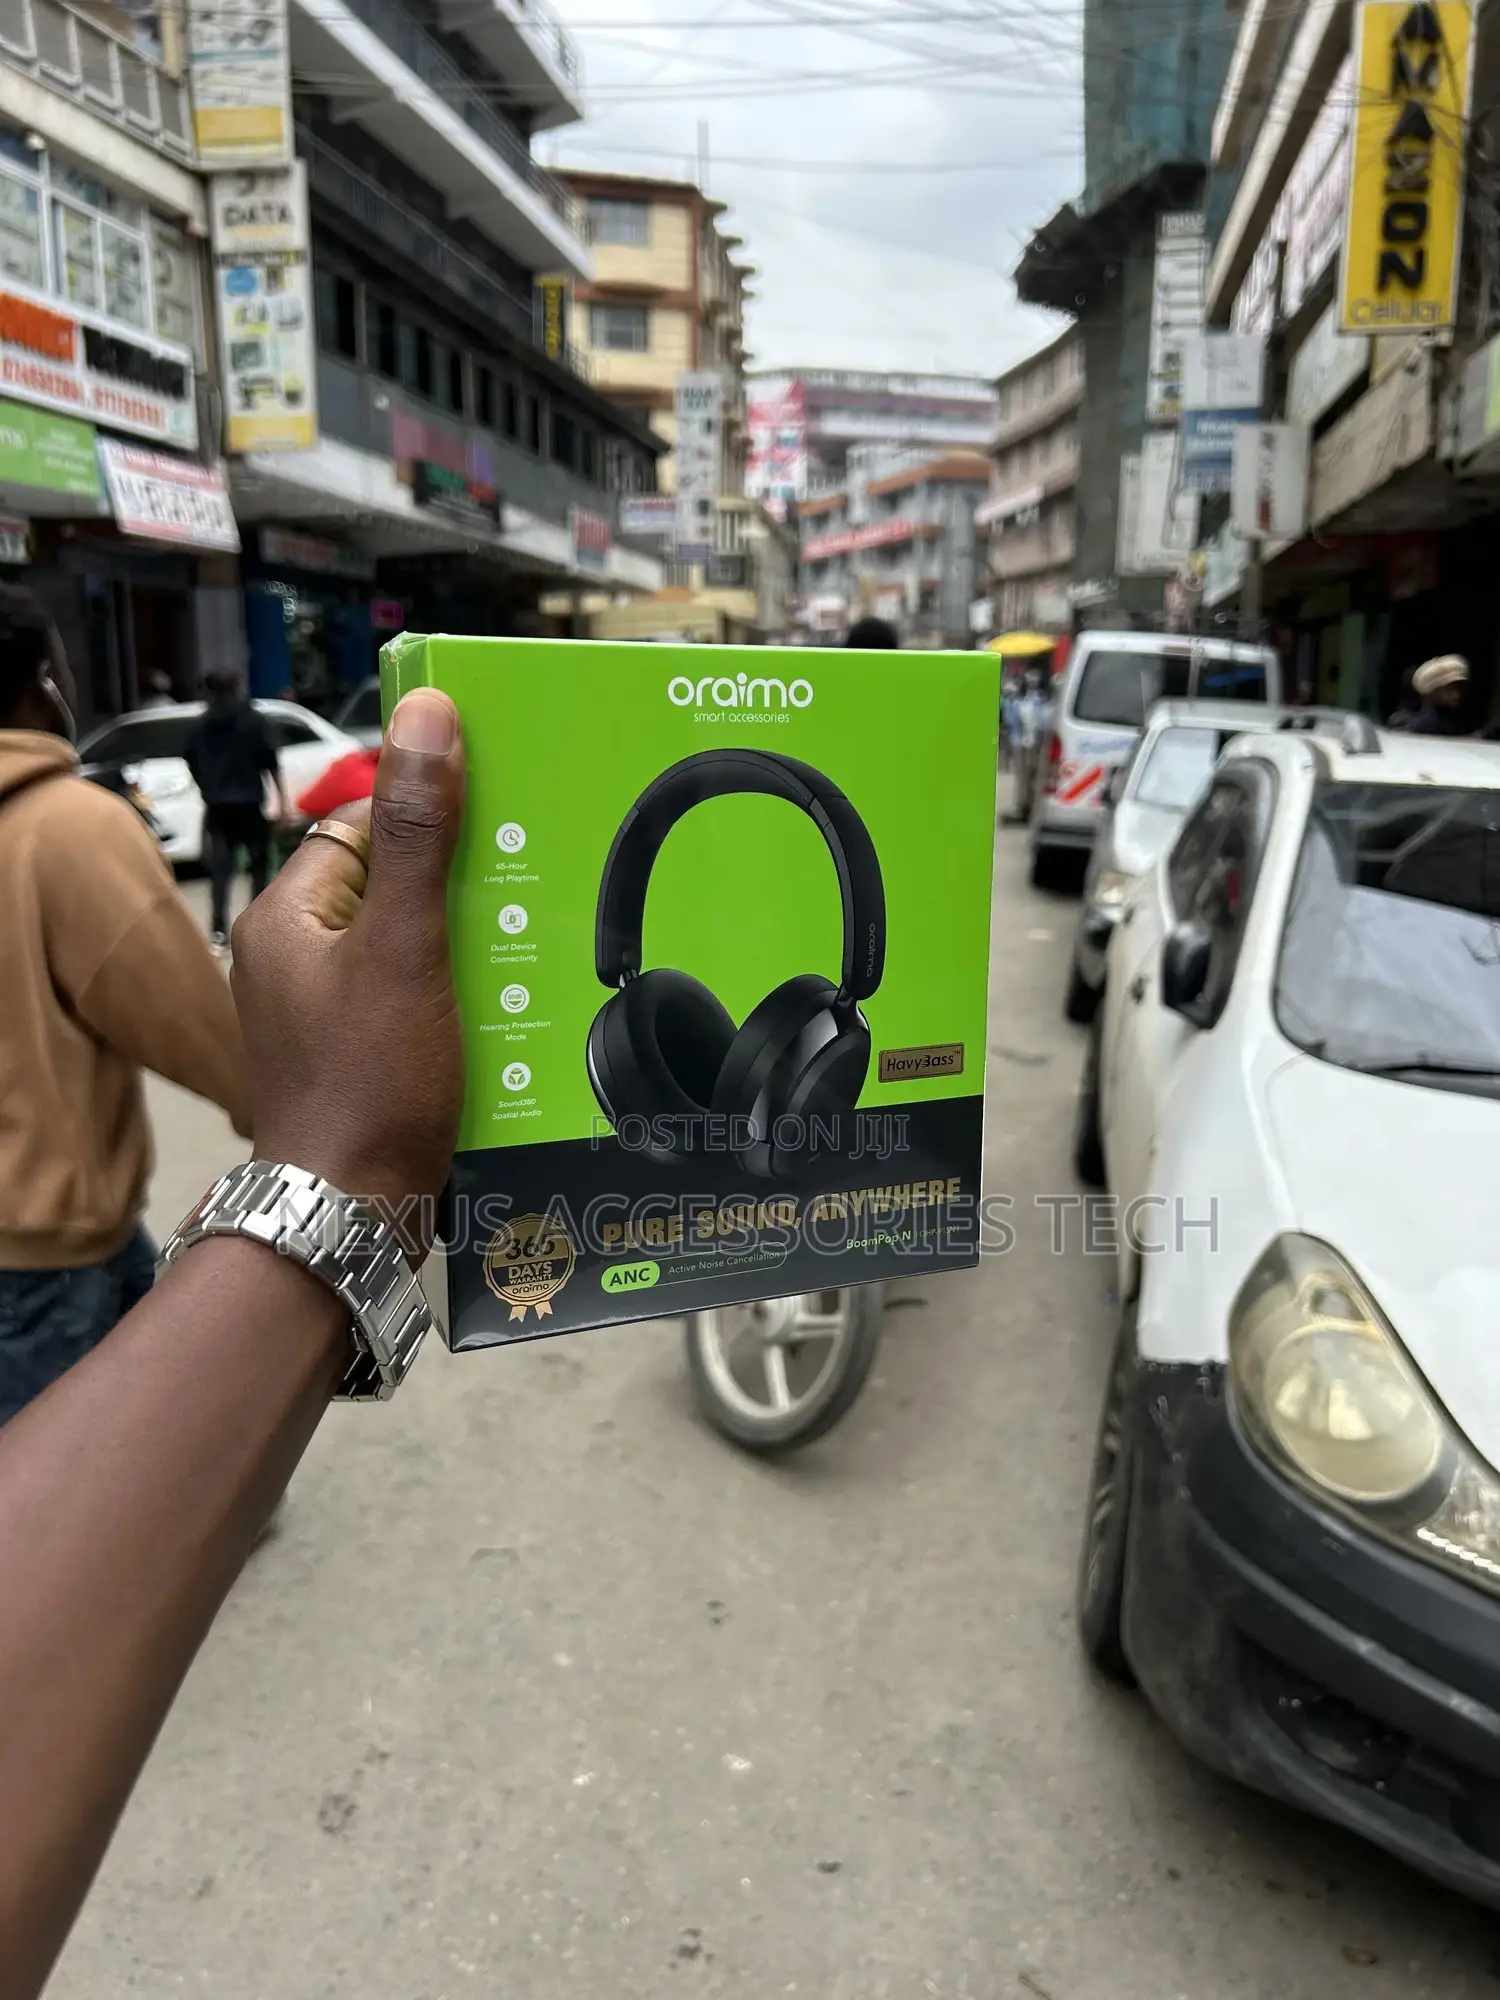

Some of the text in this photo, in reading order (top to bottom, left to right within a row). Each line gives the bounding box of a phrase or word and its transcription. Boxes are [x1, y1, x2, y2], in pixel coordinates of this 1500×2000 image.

[667, 672, 814, 708] oraimo
[694, 711, 790, 723] smart accessories
[484, 874, 540, 884] Long Playtime
[490, 942, 537, 952] Dual Device
[866, 922, 876, 978] oraimo
[490, 954, 538, 964] Connectivity
[479, 1020, 551, 1032] Hearing Protection
[504, 1033, 527, 1042] Mode
[498, 1098, 537, 1108] Sound360
[492, 1109, 542, 1121] Spatial Audio
[602, 1213, 685, 1252] PURE
[809, 1176, 962, 1223] ANYWHERE
[846, 1232, 900, 1250] BoomPop
[901, 1229, 912, 1242] N
[504, 1232, 556, 1260] 365
[668, 1250, 781, 1275] Active Noise Cancellation
[508, 1261, 553, 1279] DAYS
[510, 1273, 553, 1285] WARRANTY
[609, 1267, 651, 1287] ANC
[512, 1283, 550, 1295] oraimo
